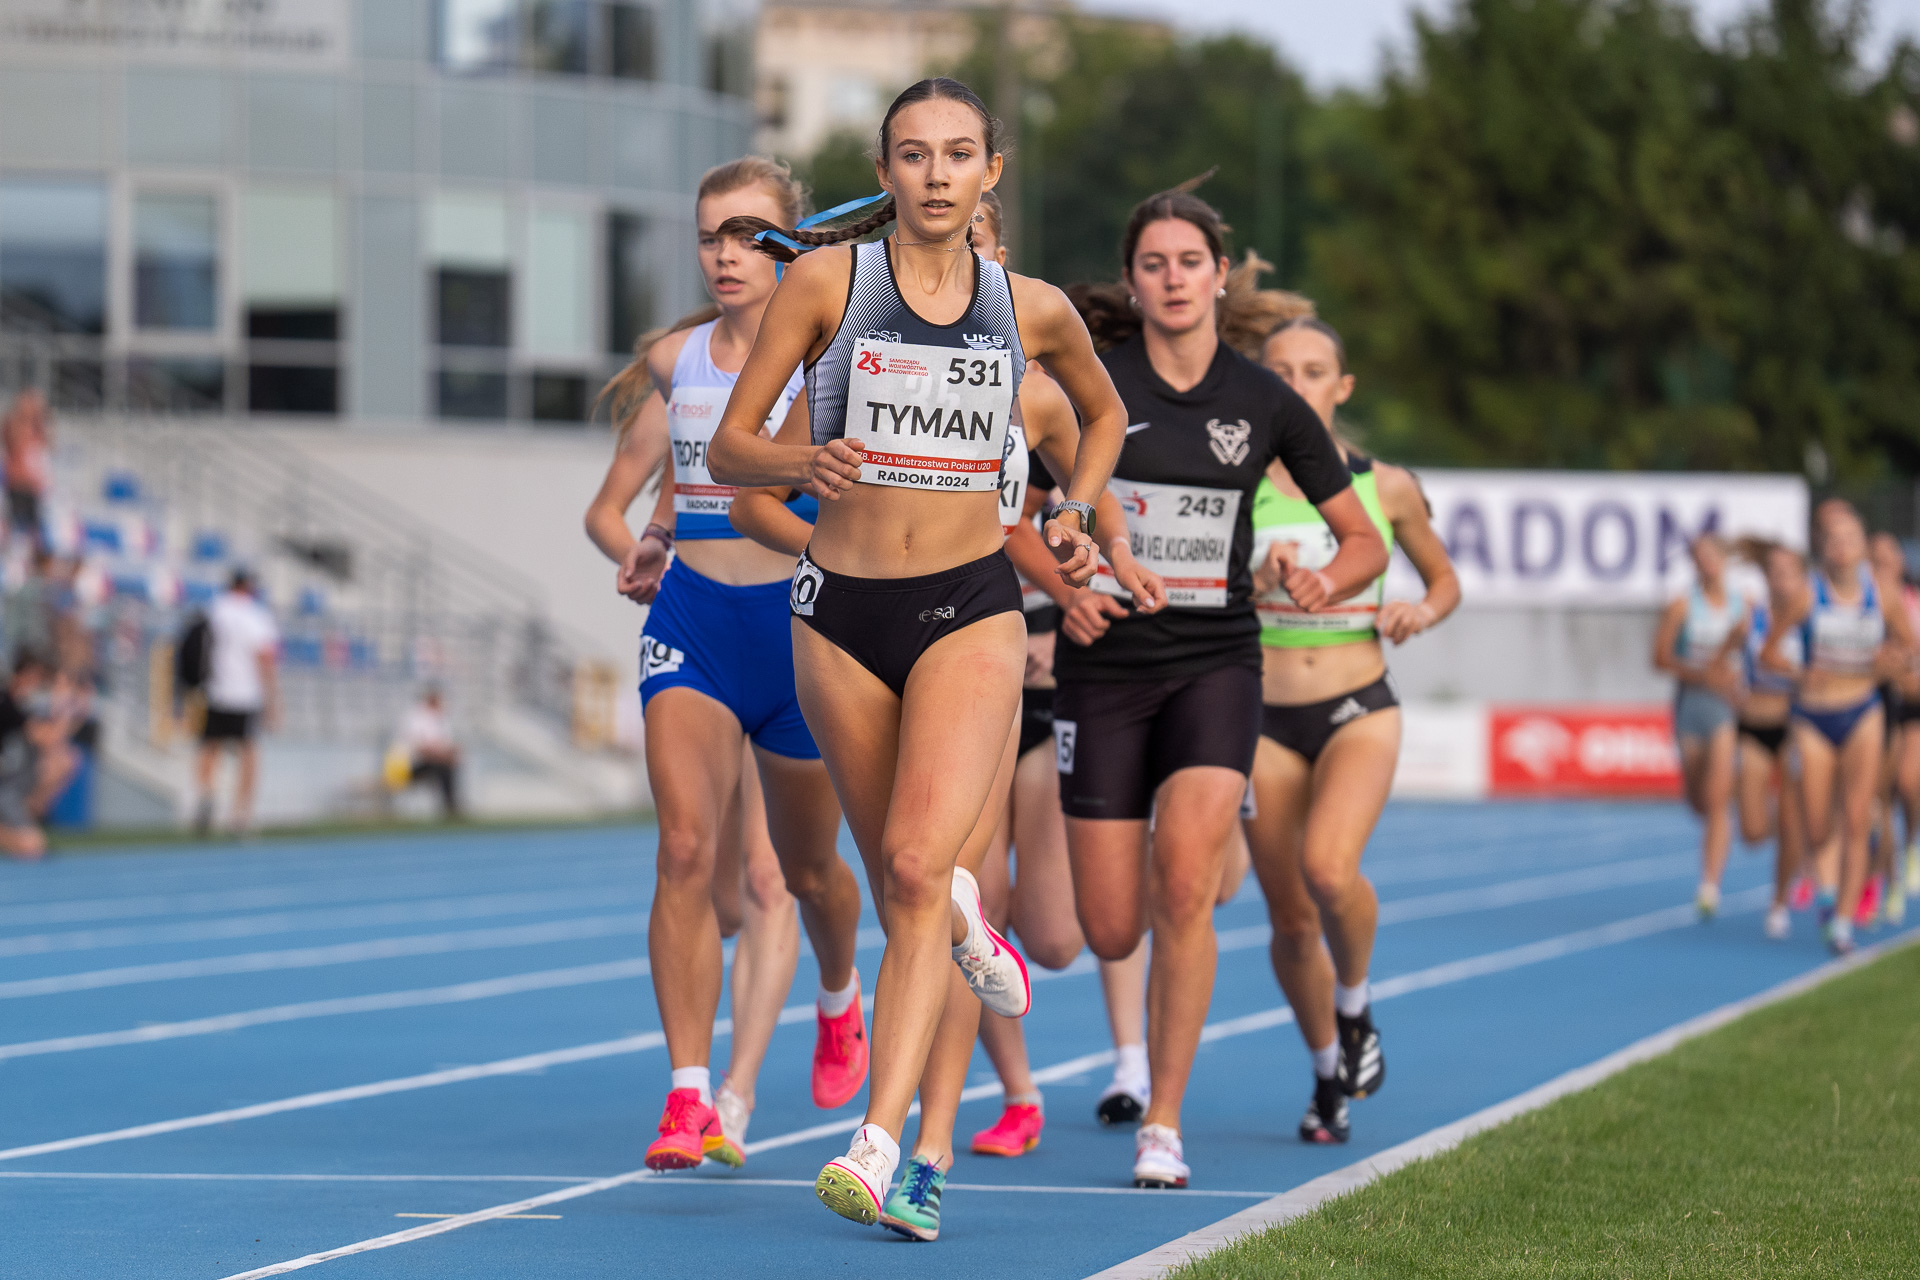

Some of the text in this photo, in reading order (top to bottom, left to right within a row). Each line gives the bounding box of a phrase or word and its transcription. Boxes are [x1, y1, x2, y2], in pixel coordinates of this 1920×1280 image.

[962, 333, 1005, 345] UKS
[946, 357, 1002, 387] 531
[866, 401, 994, 442] TYMAN
[872, 454, 893, 464] PZLA
[895, 456, 949, 470] Mistrzostwa
[951, 461, 976, 471] Polski
[977, 462, 991, 471] U20
[877, 469, 970, 488] RADOM 2024
[1177, 494, 1226, 517] 243
